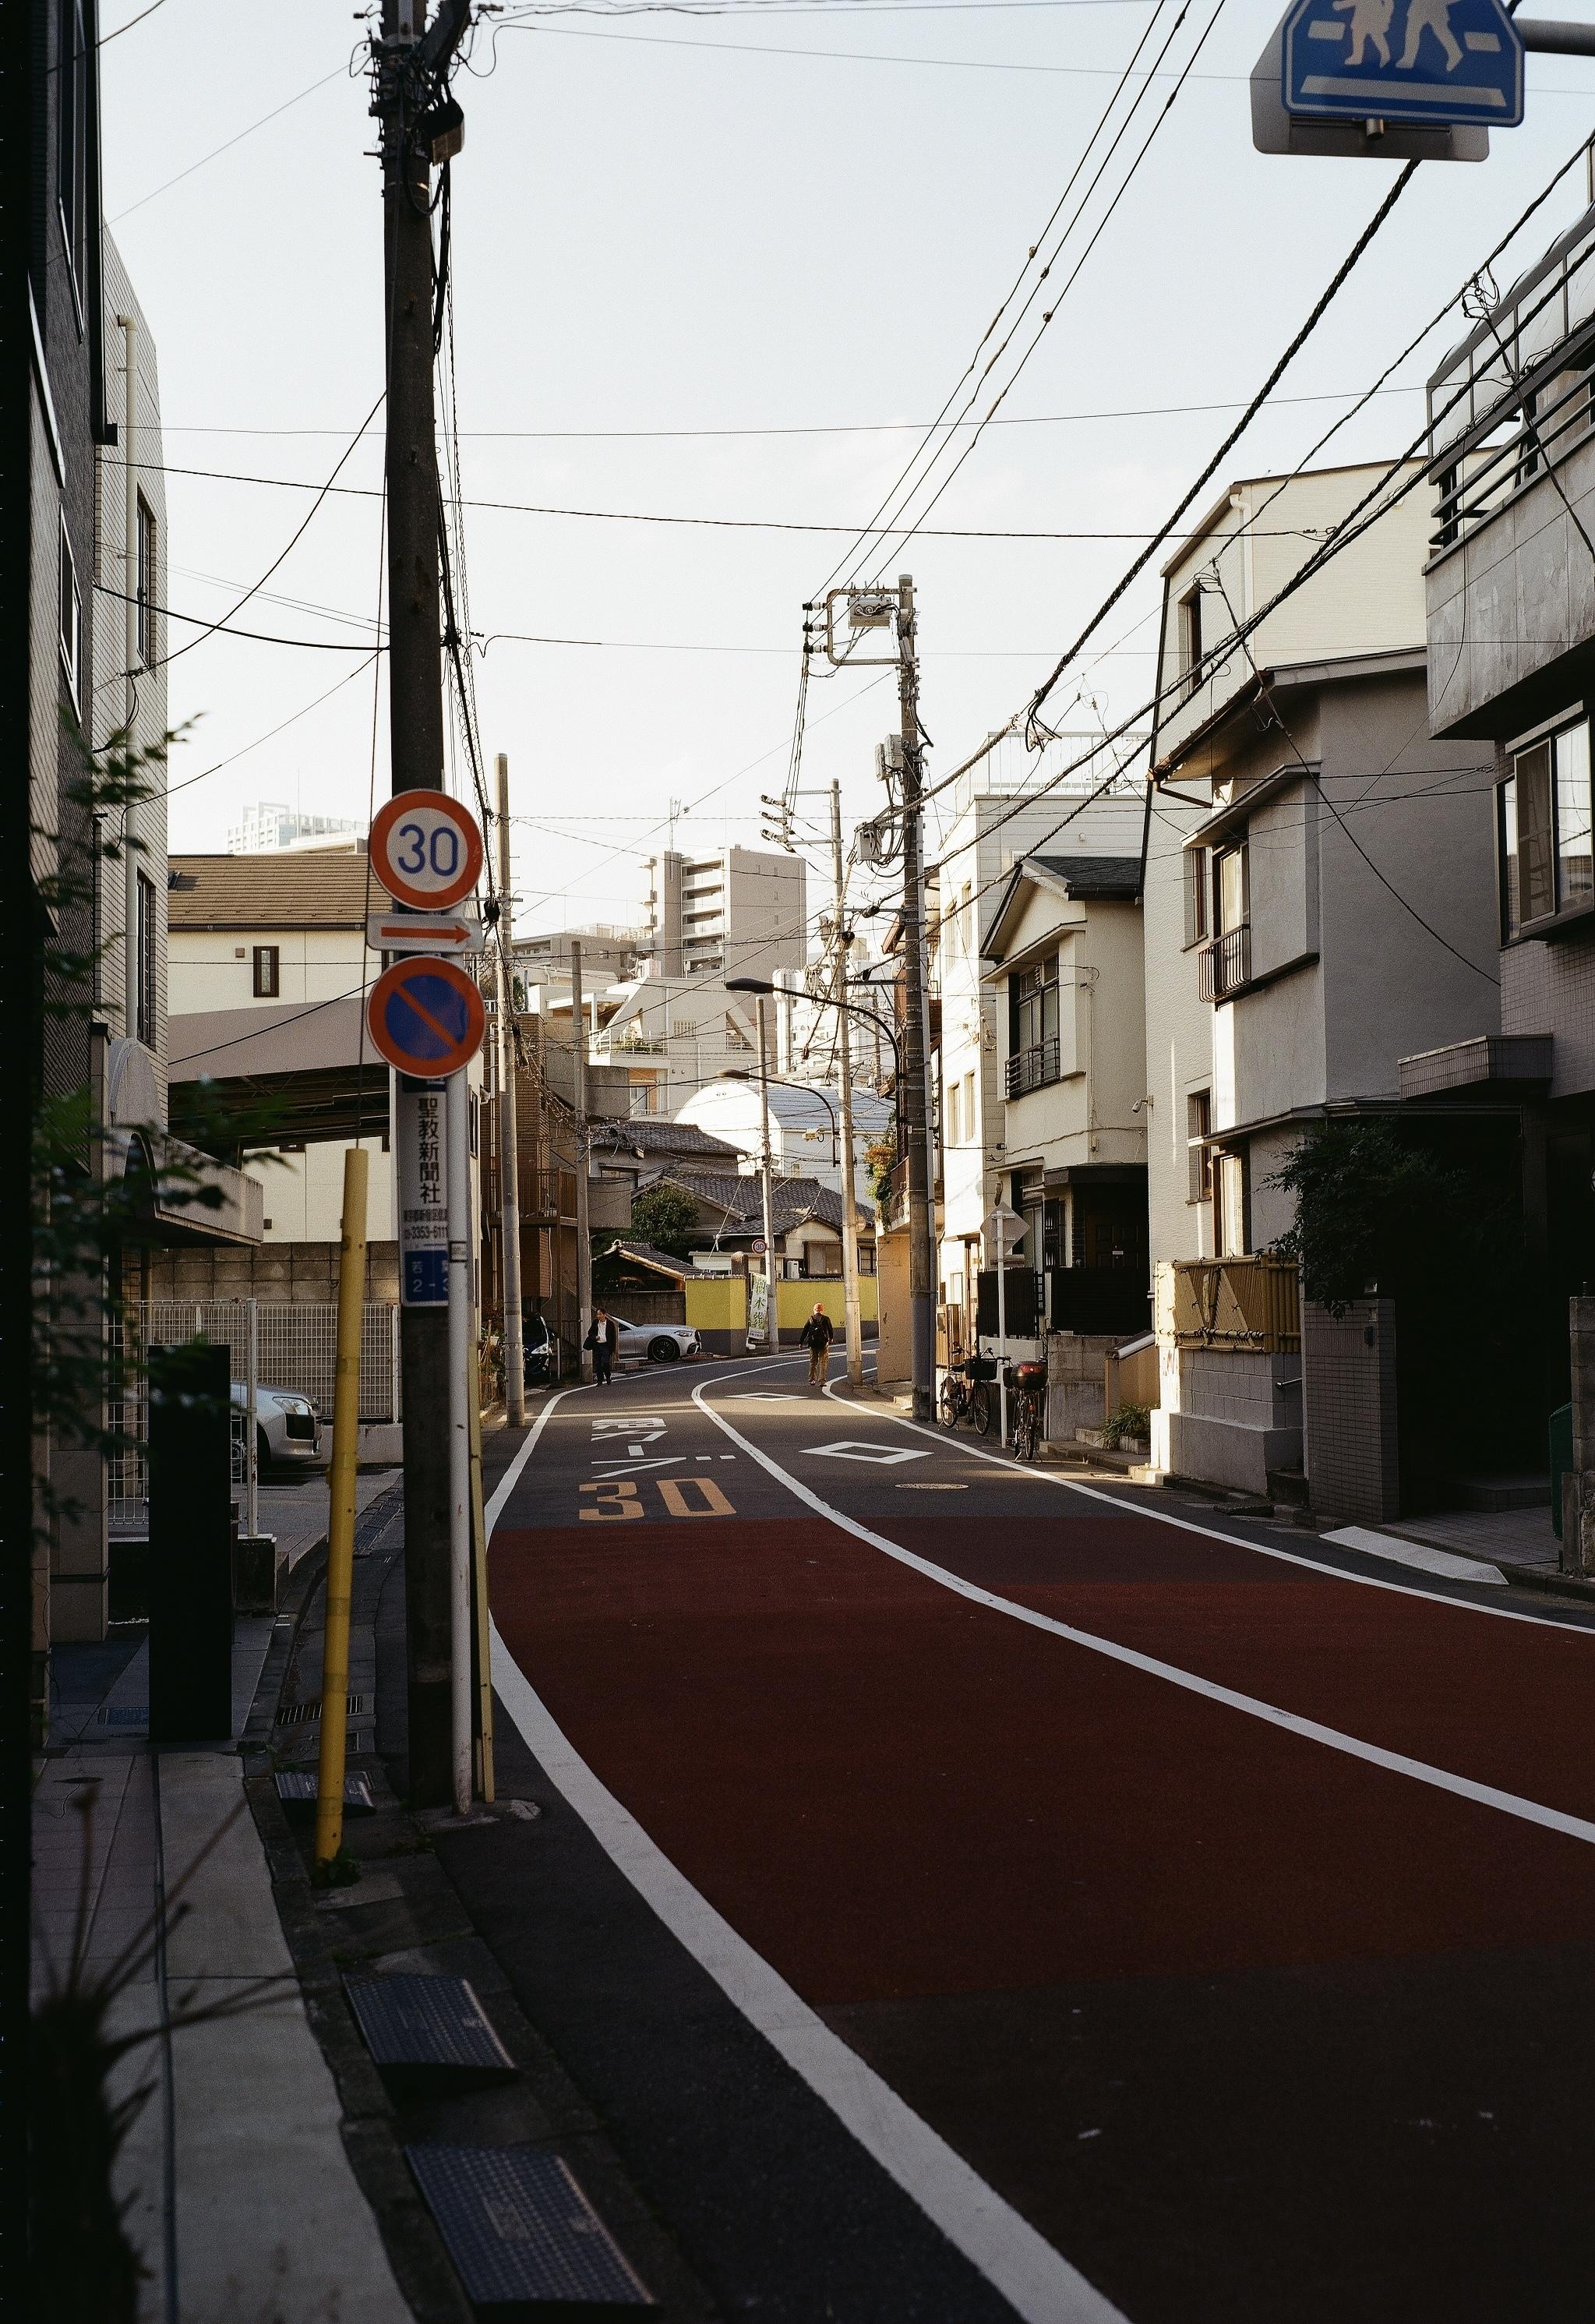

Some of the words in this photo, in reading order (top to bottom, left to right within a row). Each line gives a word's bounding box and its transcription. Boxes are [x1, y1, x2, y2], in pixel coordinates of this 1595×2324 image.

[397, 824, 458, 876] 30
[418, 1097, 441, 1204] 聖教新聞社
[591, 1417, 736, 1478] 急カーブ
[579, 1478, 737, 1521] 30
